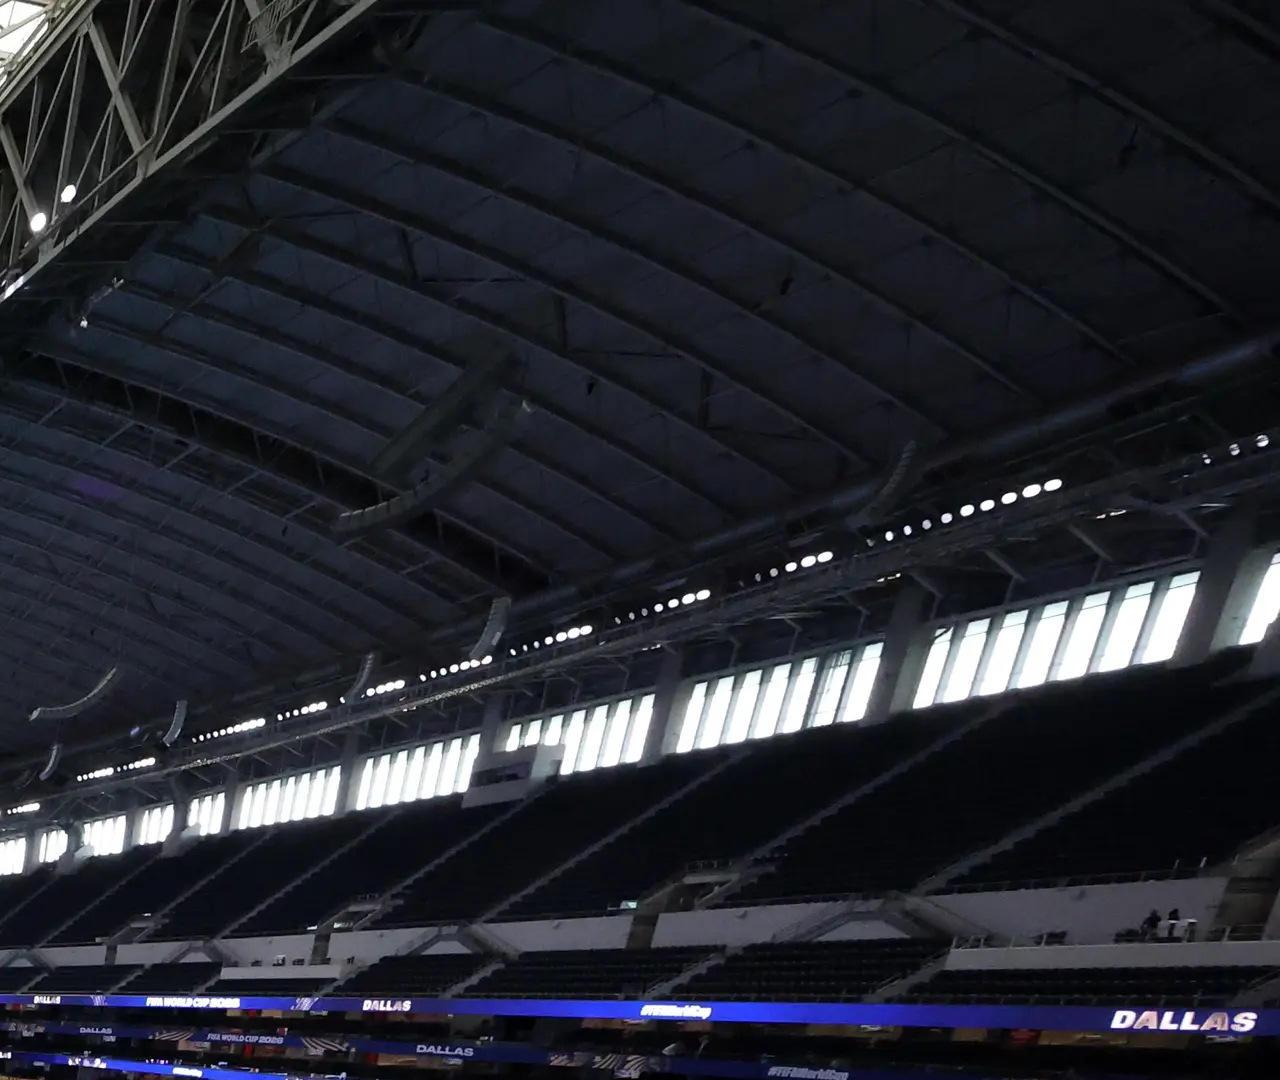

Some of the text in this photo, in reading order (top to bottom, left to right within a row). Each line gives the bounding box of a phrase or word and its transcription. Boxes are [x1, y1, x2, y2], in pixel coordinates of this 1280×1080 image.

[34, 996, 61, 1004] DALLAS
[363, 1000, 412, 1011] DALLAS
[1111, 1010, 1258, 1032] DALLAS
[207, 1033, 284, 1044] FIFA WORLD CUP 2026
[416, 1045, 474, 1057] DALLAS
